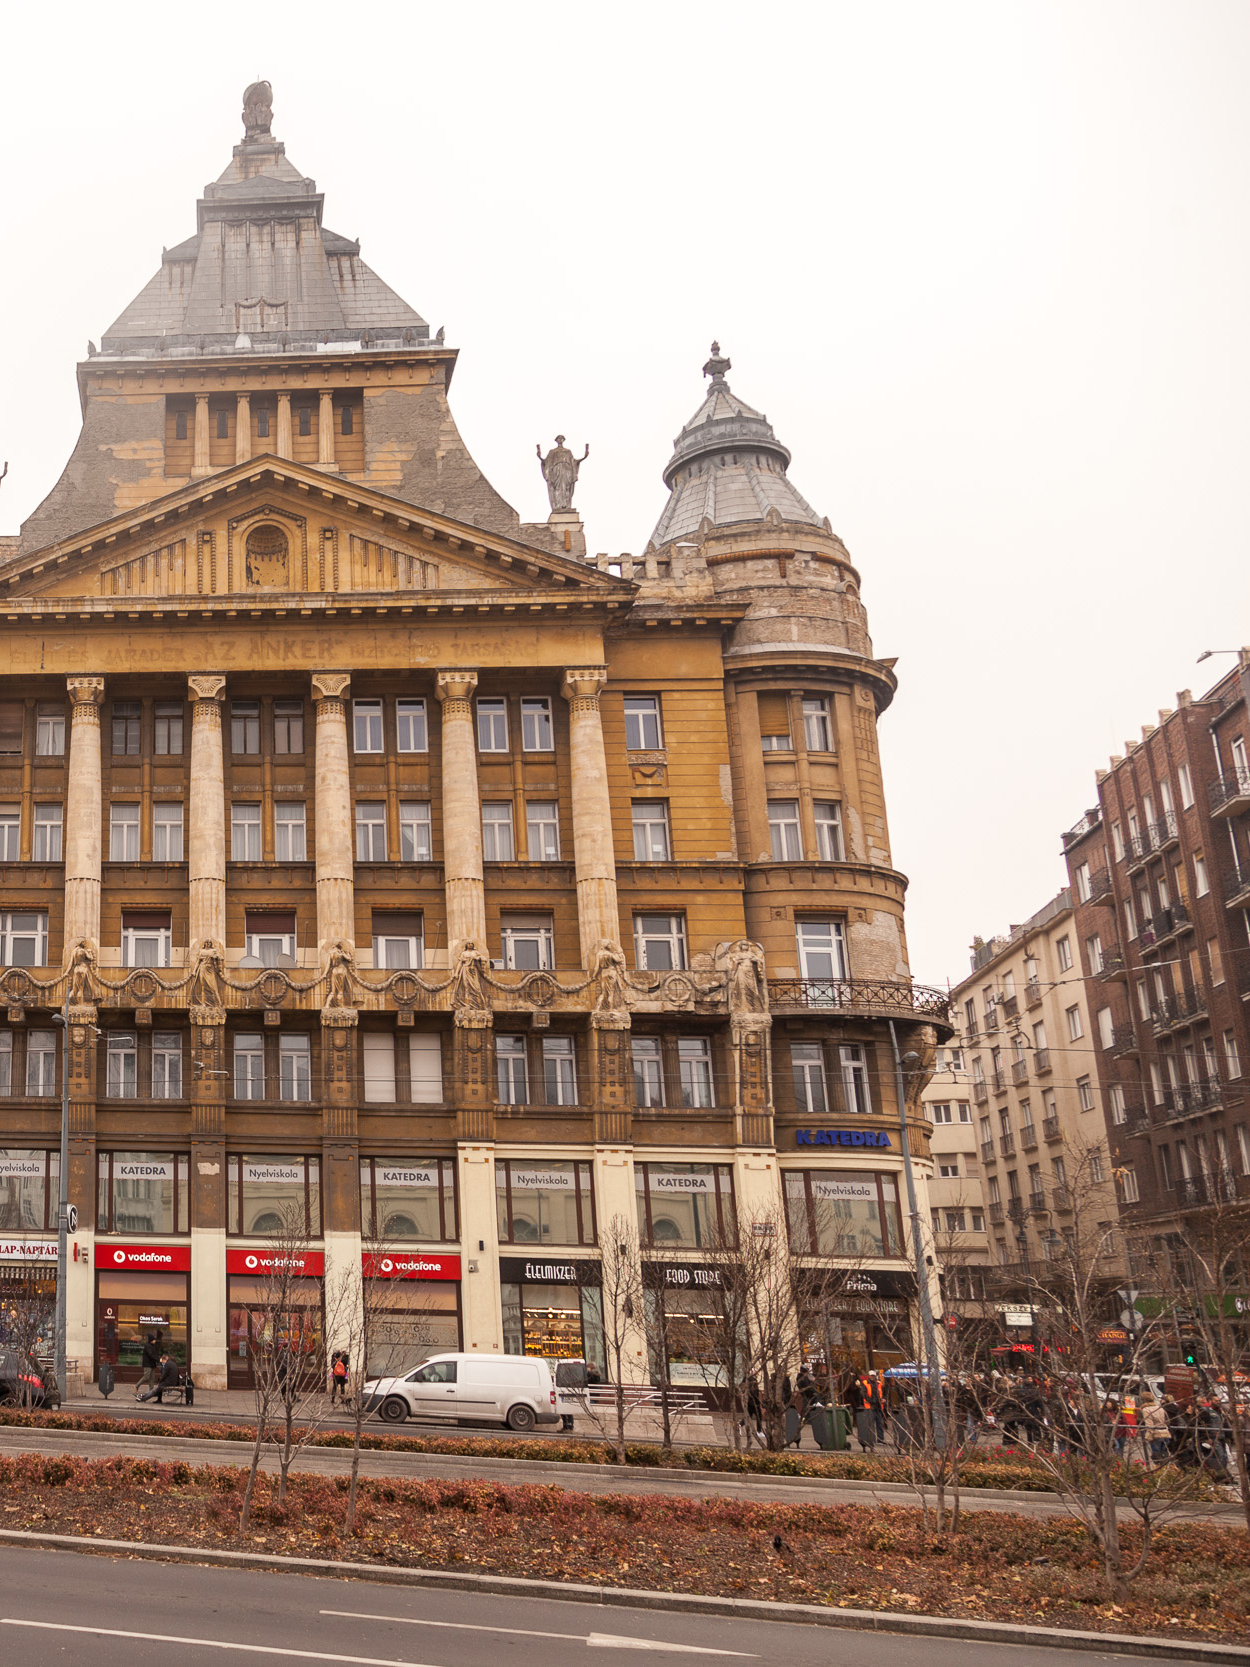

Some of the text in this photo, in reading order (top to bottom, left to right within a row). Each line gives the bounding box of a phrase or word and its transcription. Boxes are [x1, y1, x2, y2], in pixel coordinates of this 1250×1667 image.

[796, 1129, 892, 1147] KATEDRA
[120, 1166, 167, 1176] KATEDRA
[249, 1168, 298, 1179] Nyelviskola
[383, 1171, 431, 1182] KATEDRA
[517, 1174, 569, 1186] Nyelviskola
[657, 1177, 707, 1188] KATEDRA
[818, 1185, 871, 1197] Nyelviskola
[127, 1252, 172, 1263] vodafone
[260, 1256, 305, 1267] vodafone
[395, 1260, 442, 1271] vodafone
[525, 1262, 577, 1280] ÉLELMISZER
[666, 1269, 722, 1285] FOOD STORE
[846, 1280, 877, 1291] Prima
